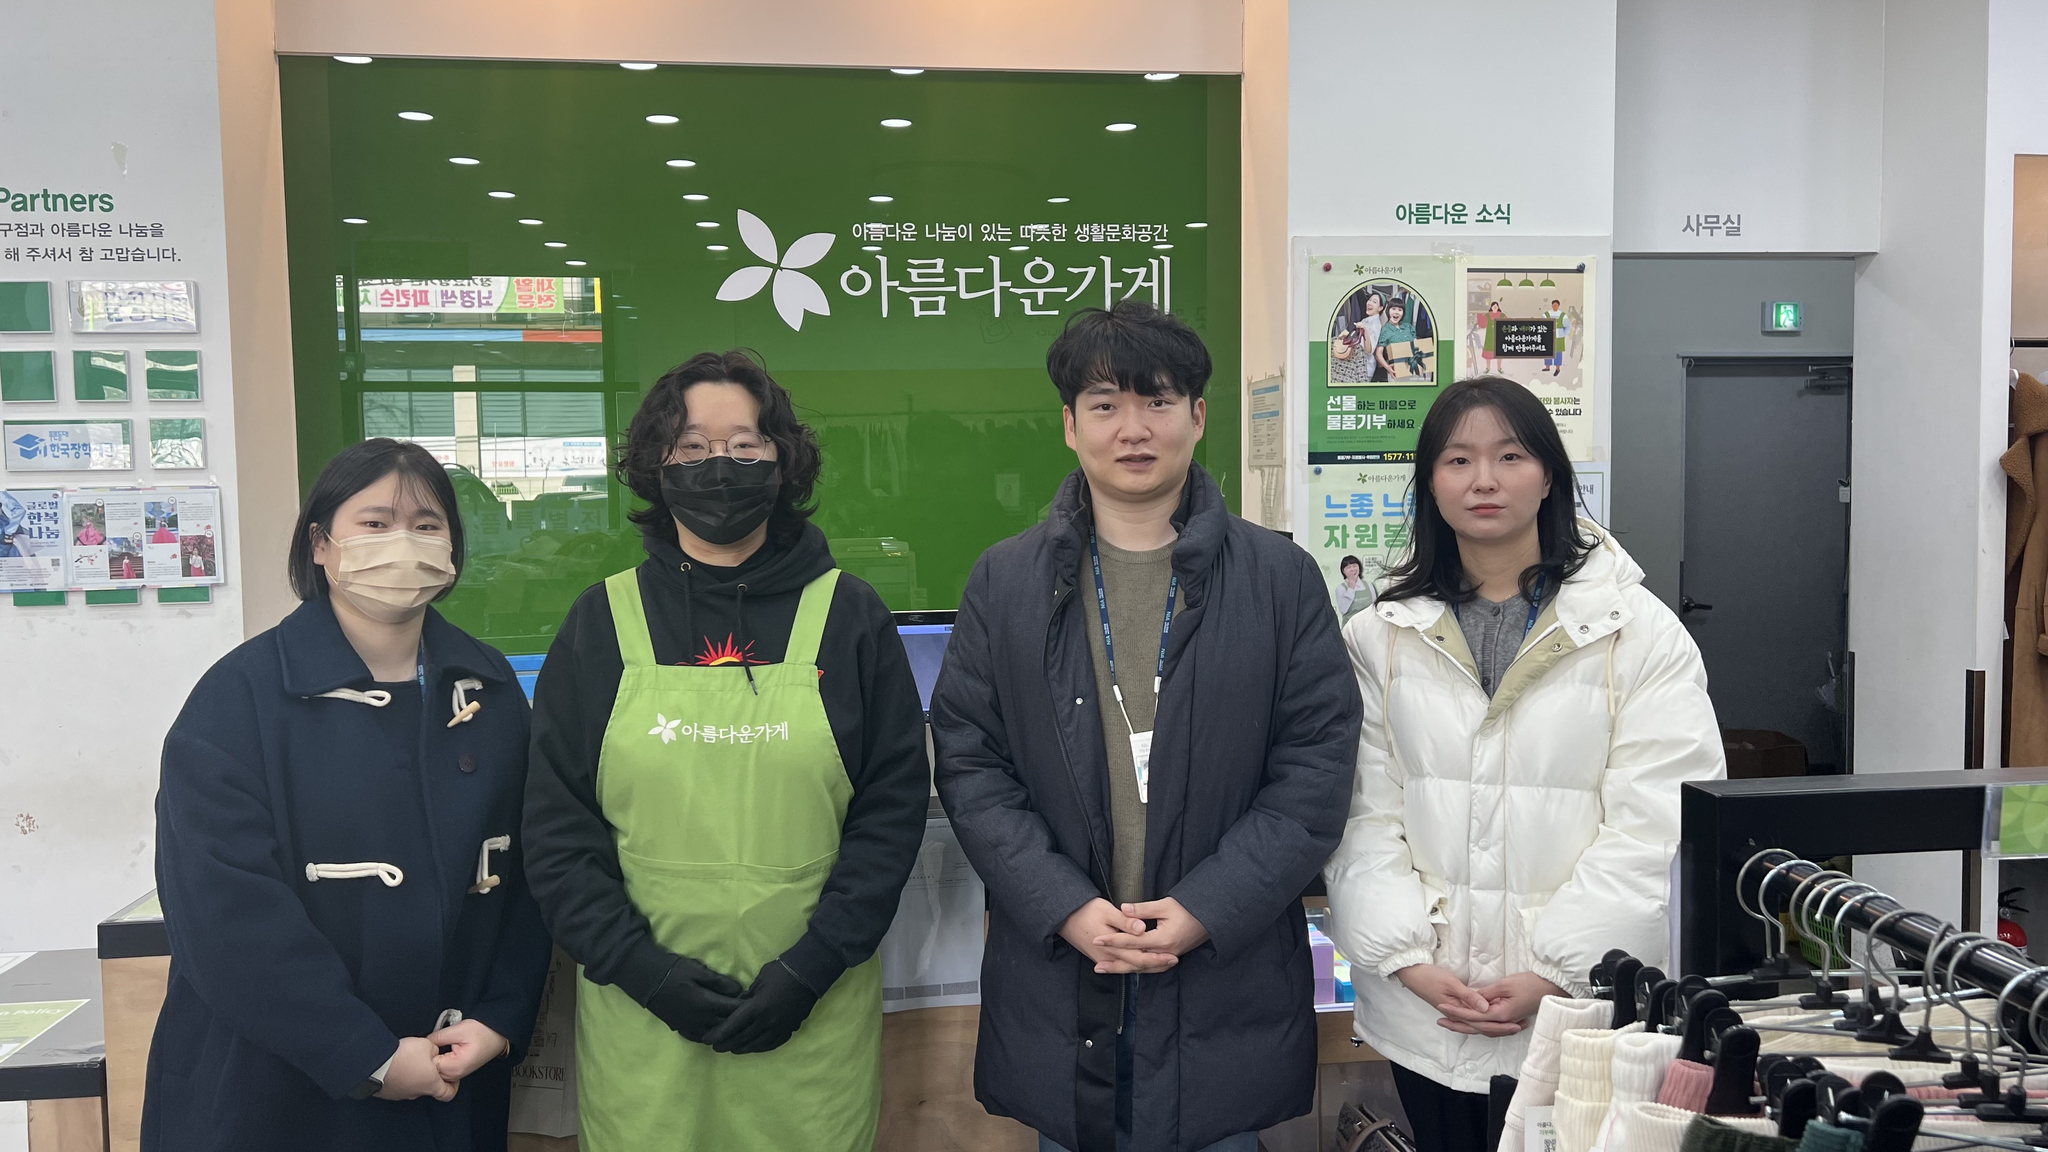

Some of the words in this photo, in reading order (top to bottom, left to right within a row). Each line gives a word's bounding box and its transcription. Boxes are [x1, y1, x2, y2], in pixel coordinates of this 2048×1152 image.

[0, 187, 114, 213] Partners
[1396, 203, 1468, 225] 아름다운
[1475, 203, 1511, 225] 소식
[0, 223, 45, 238] 구점과
[51, 223, 112, 238] 아름다운
[119, 223, 164, 238] 나눔을
[852, 222, 917, 243] 아름다운
[925, 222, 973, 243] 나눔이
[981, 222, 1013, 243] 있는
[1020, 222, 1067, 243] 따뜻한
[1074, 222, 1169, 243] 생활문화공간
[1682, 214, 1741, 237] 사무실
[4, 247, 20, 262] 해
[26, 247, 72, 262] 주셔서
[79, 247, 94, 262] 참
[100, 247, 181, 262] 고맙습니다.
[1365, 266, 1403, 275] 아름다운가게
[840, 254, 1171, 318] 아름다운가게
[1327, 395, 1375, 411] 선물하는
[1379, 400, 1416, 410] 마음으로
[1555, 408, 1582, 416] 있습니다
[1327, 414, 1415, 430] 물품기부하세요
[1368, 474, 1406, 483] 아름다운가게
[27, 512, 59, 525] 한복
[28, 526, 60, 539] 나눔
[682, 721, 789, 744] 아름다운가게
[13, 1008, 66, 1016] Policy
